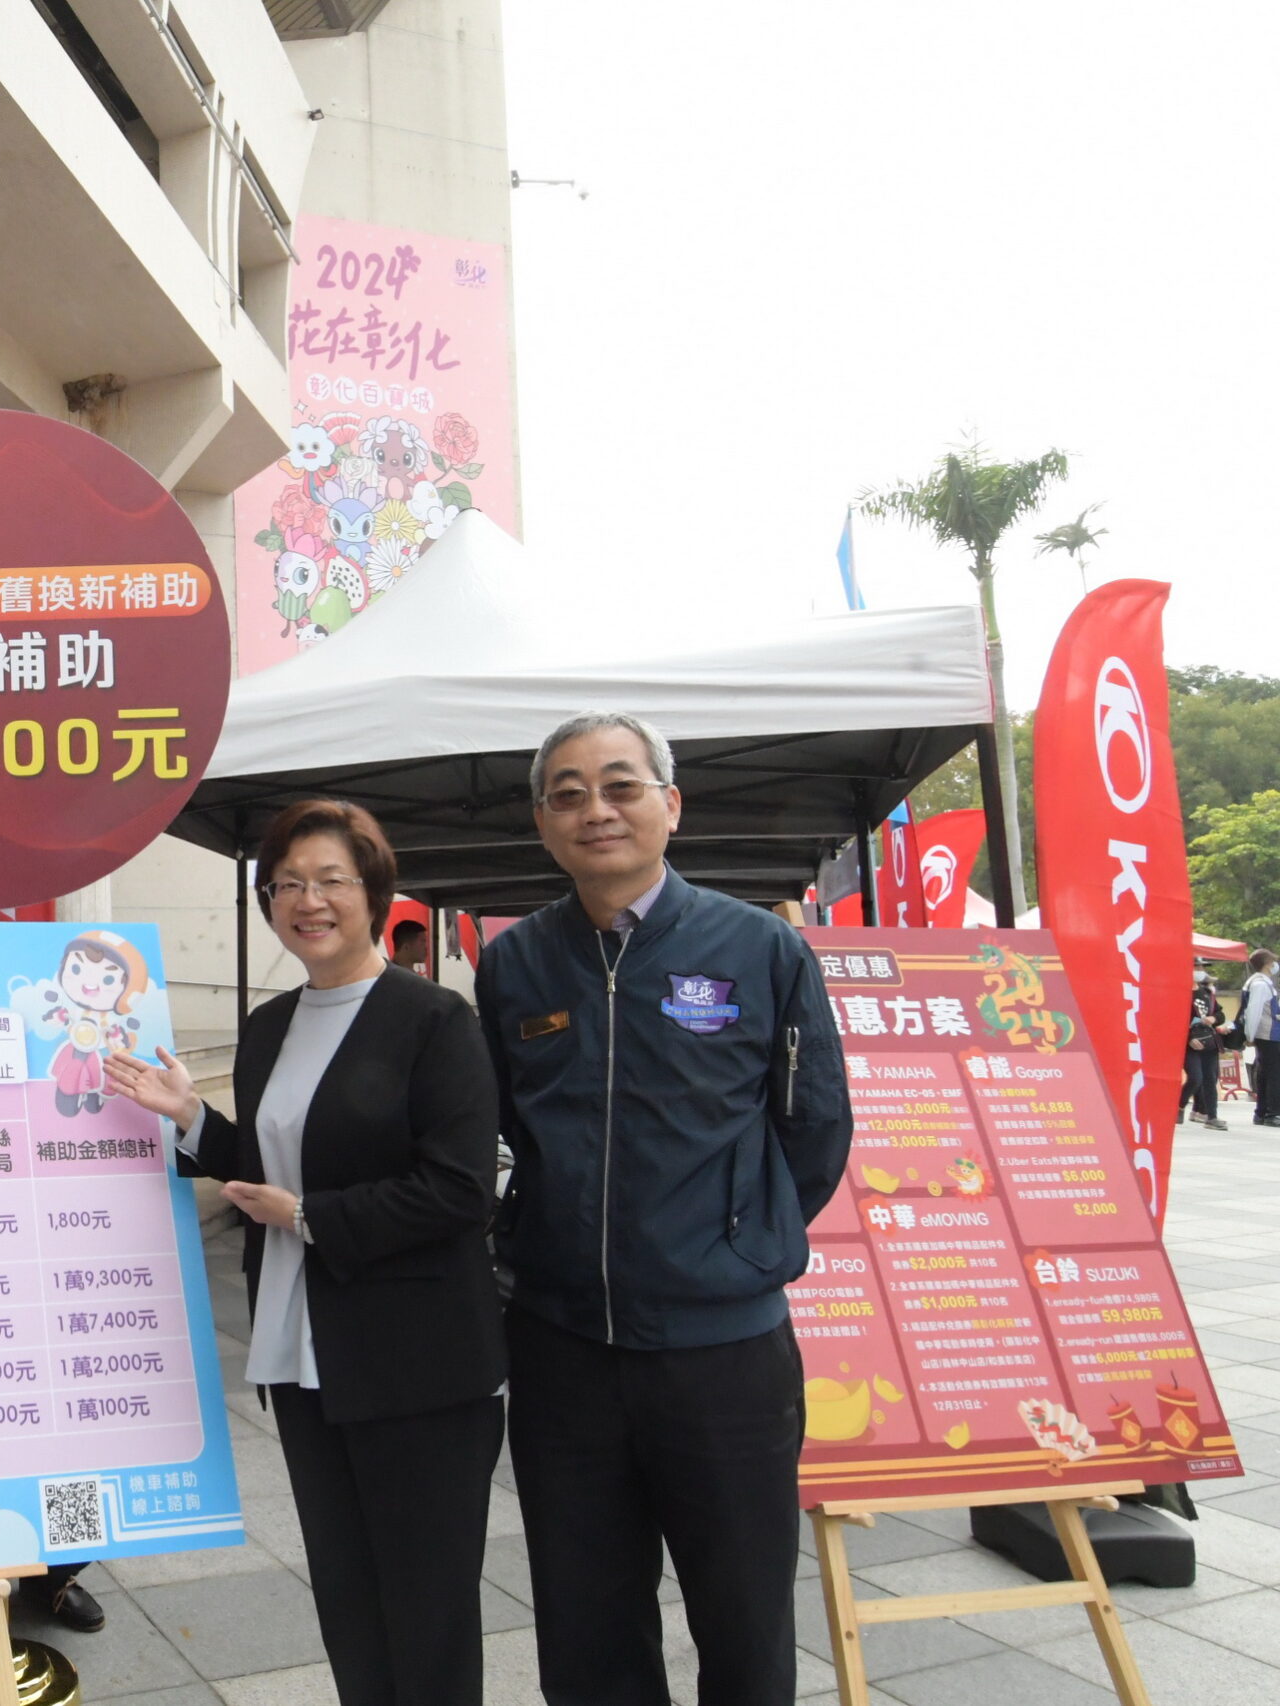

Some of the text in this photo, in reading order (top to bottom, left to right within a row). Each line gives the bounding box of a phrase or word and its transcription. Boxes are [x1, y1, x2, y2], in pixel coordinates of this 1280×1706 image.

[316, 244, 421, 300] 2024
[821, 955, 893, 978] 定優惠
[871, 1066, 936, 1079] YAMAHA
[966, 1055, 1063, 1081] 睿能 Gogoro
[1030, 1101, 1074, 1114] $4,888
[36, 1137, 157, 1162] 補助金額總計
[1061, 1169, 1106, 1184] $6,000
[47, 1210, 112, 1230] 1,800元
[867, 1204, 990, 1230] 中華 eMOVING
[1073, 1202, 1118, 1216] $2,000
[831, 1258, 866, 1274] PGO
[1034, 1257, 1140, 1284] 台鈴 SUZUKI
[53, 1267, 153, 1292] 1萬9,300元
[57, 1310, 159, 1335] 1萬7,400元
[1101, 1307, 1163, 1324] 59,980元
[60, 1352, 164, 1379] 1萬2,000元
[65, 1395, 151, 1422] 1萬100元
[129, 1470, 198, 1493] 機車補助
